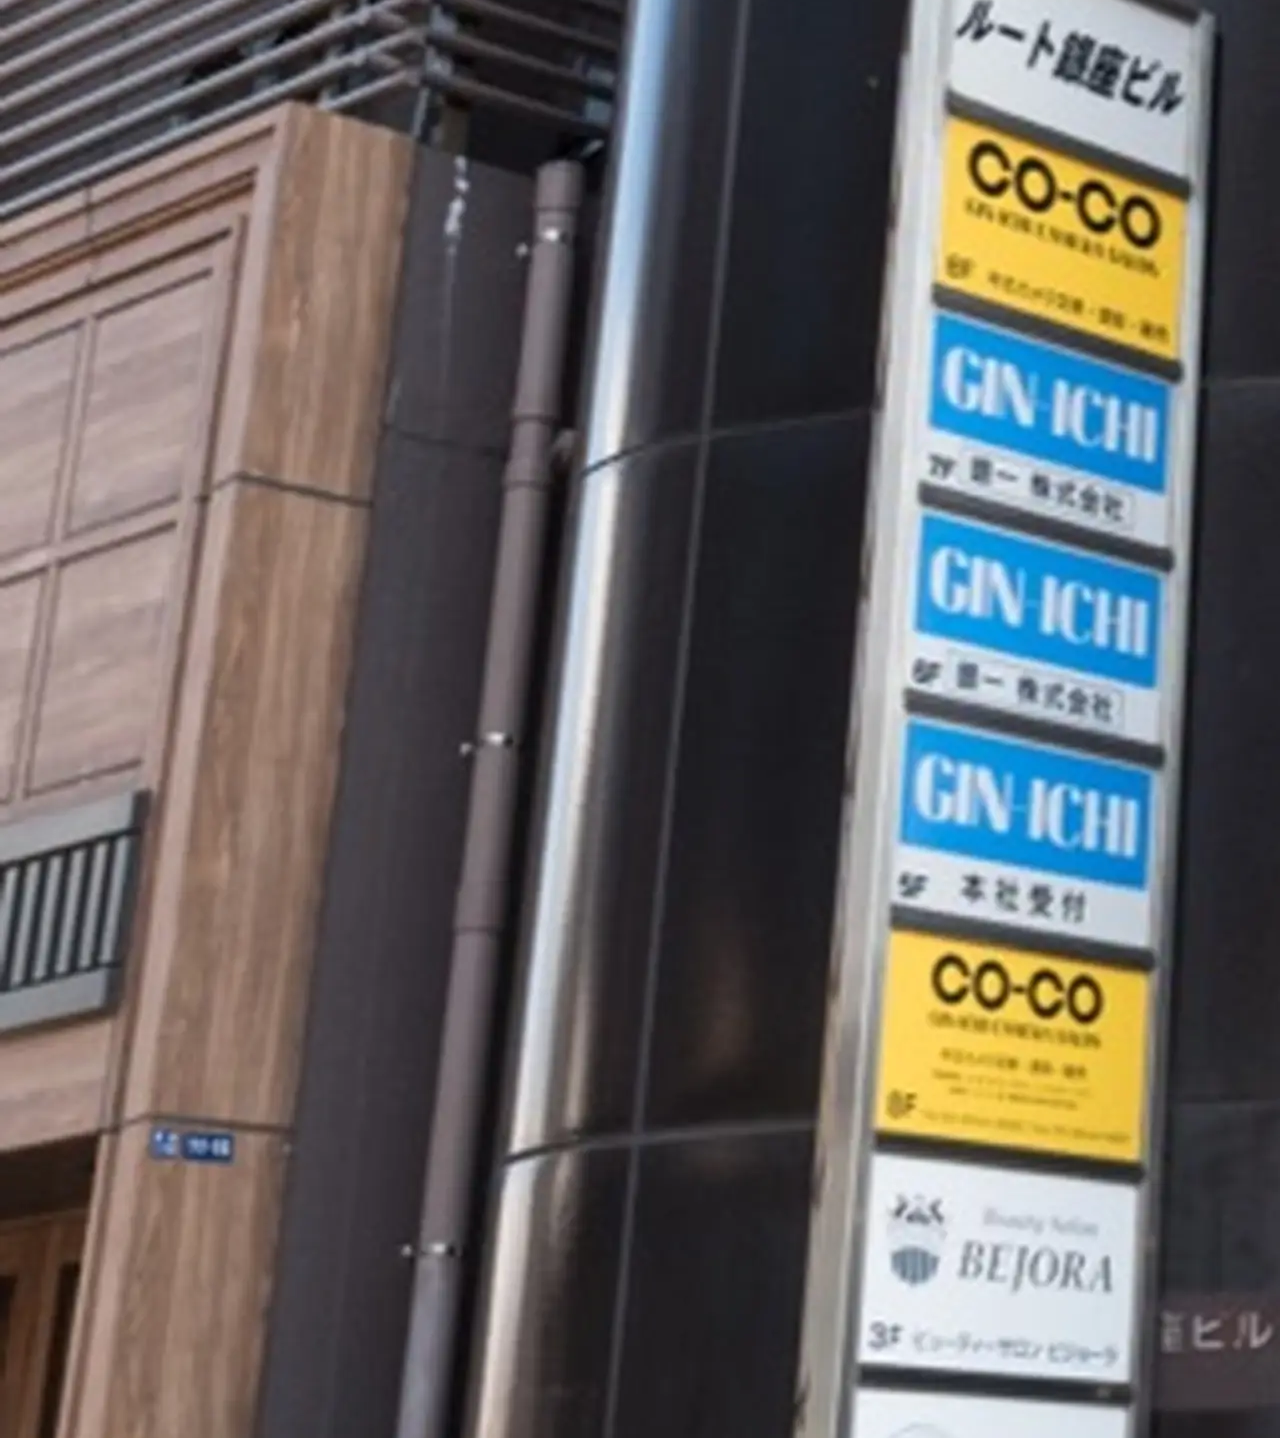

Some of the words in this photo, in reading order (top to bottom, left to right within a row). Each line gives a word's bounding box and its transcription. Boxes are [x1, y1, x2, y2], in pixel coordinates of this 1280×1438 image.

[968, 139, 1162, 250] CO-CO
[961, 872, 1087, 924] 本社受付
[931, 953, 1105, 1026] CO-CO
[957, 1239, 1113, 1295] BEJORA
